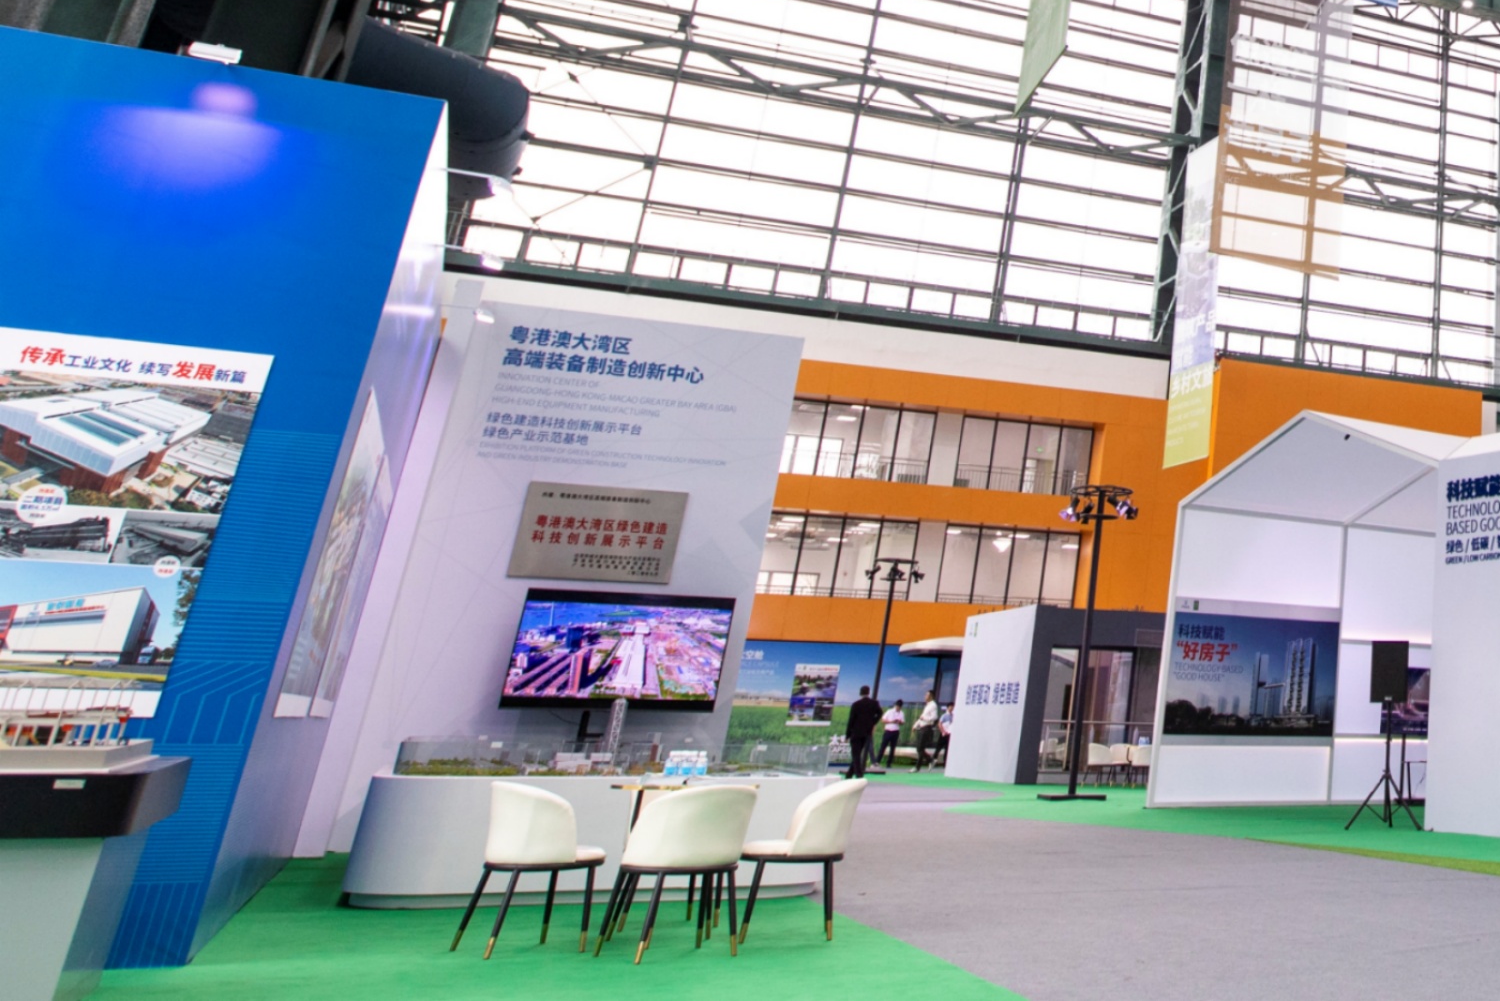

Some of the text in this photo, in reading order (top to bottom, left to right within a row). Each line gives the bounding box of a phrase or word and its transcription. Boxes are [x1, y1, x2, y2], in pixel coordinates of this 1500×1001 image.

[509, 325, 632, 355] 粤港澳大湾区
[20, 345, 247, 384] 传承工业文化 续写发展新篇
[502, 348, 704, 384] 高端装备制造创新中心
[499, 372, 551, 383] INNOVATION
[486, 412, 642, 435] 绿色建造科技创新展示平台
[482, 426, 589, 446] 绿色产业示范基地
[536, 514, 668, 535] 粤港澳大湾区绿色建造
[1446, 519, 1478, 535] BASED
[531, 530, 665, 550] 科技创新展示平台
[1178, 624, 1225, 641] 科技赋能
[1176, 641, 1238, 662] “好房子”
